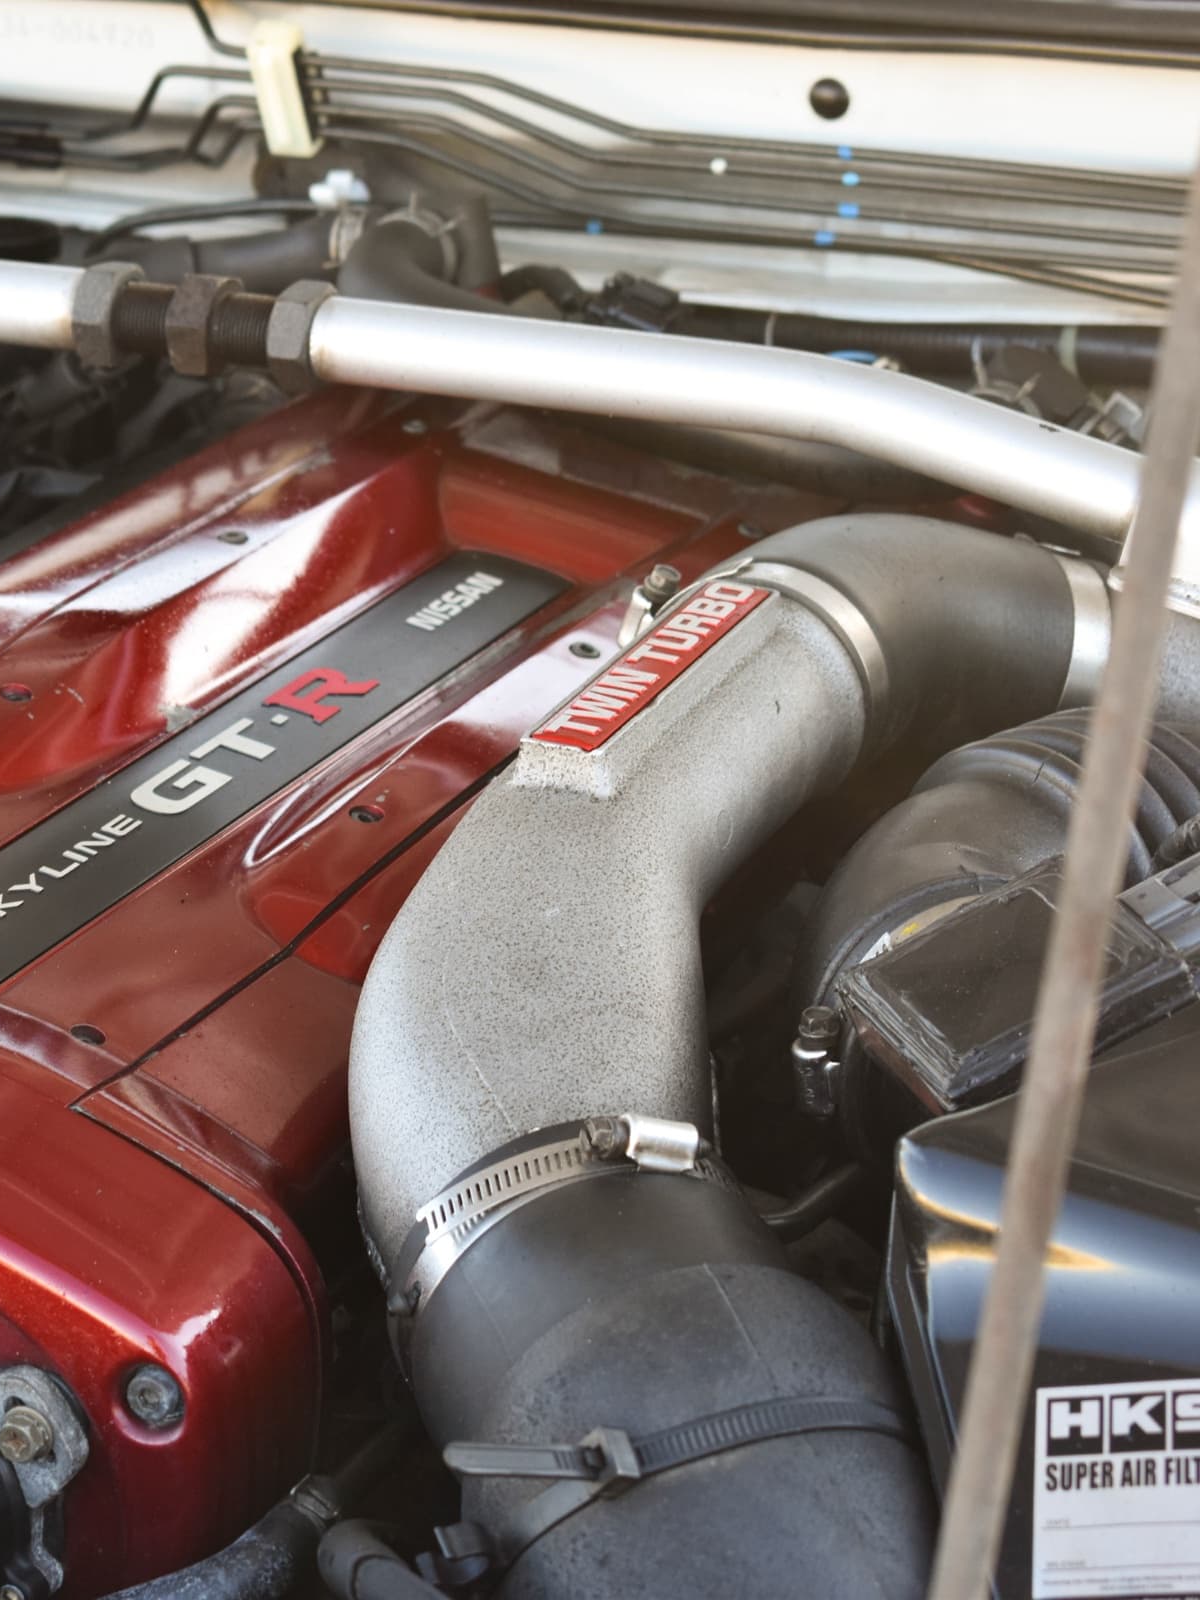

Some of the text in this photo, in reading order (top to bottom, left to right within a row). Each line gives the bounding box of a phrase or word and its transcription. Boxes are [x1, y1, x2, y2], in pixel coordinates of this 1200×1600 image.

[405, 571, 504, 632] NISSAN
[544, 581, 755, 736] TWIN TURBO
[1045, 1460, 1114, 1492] SUPER
[1120, 1457, 1157, 1487] AIR
